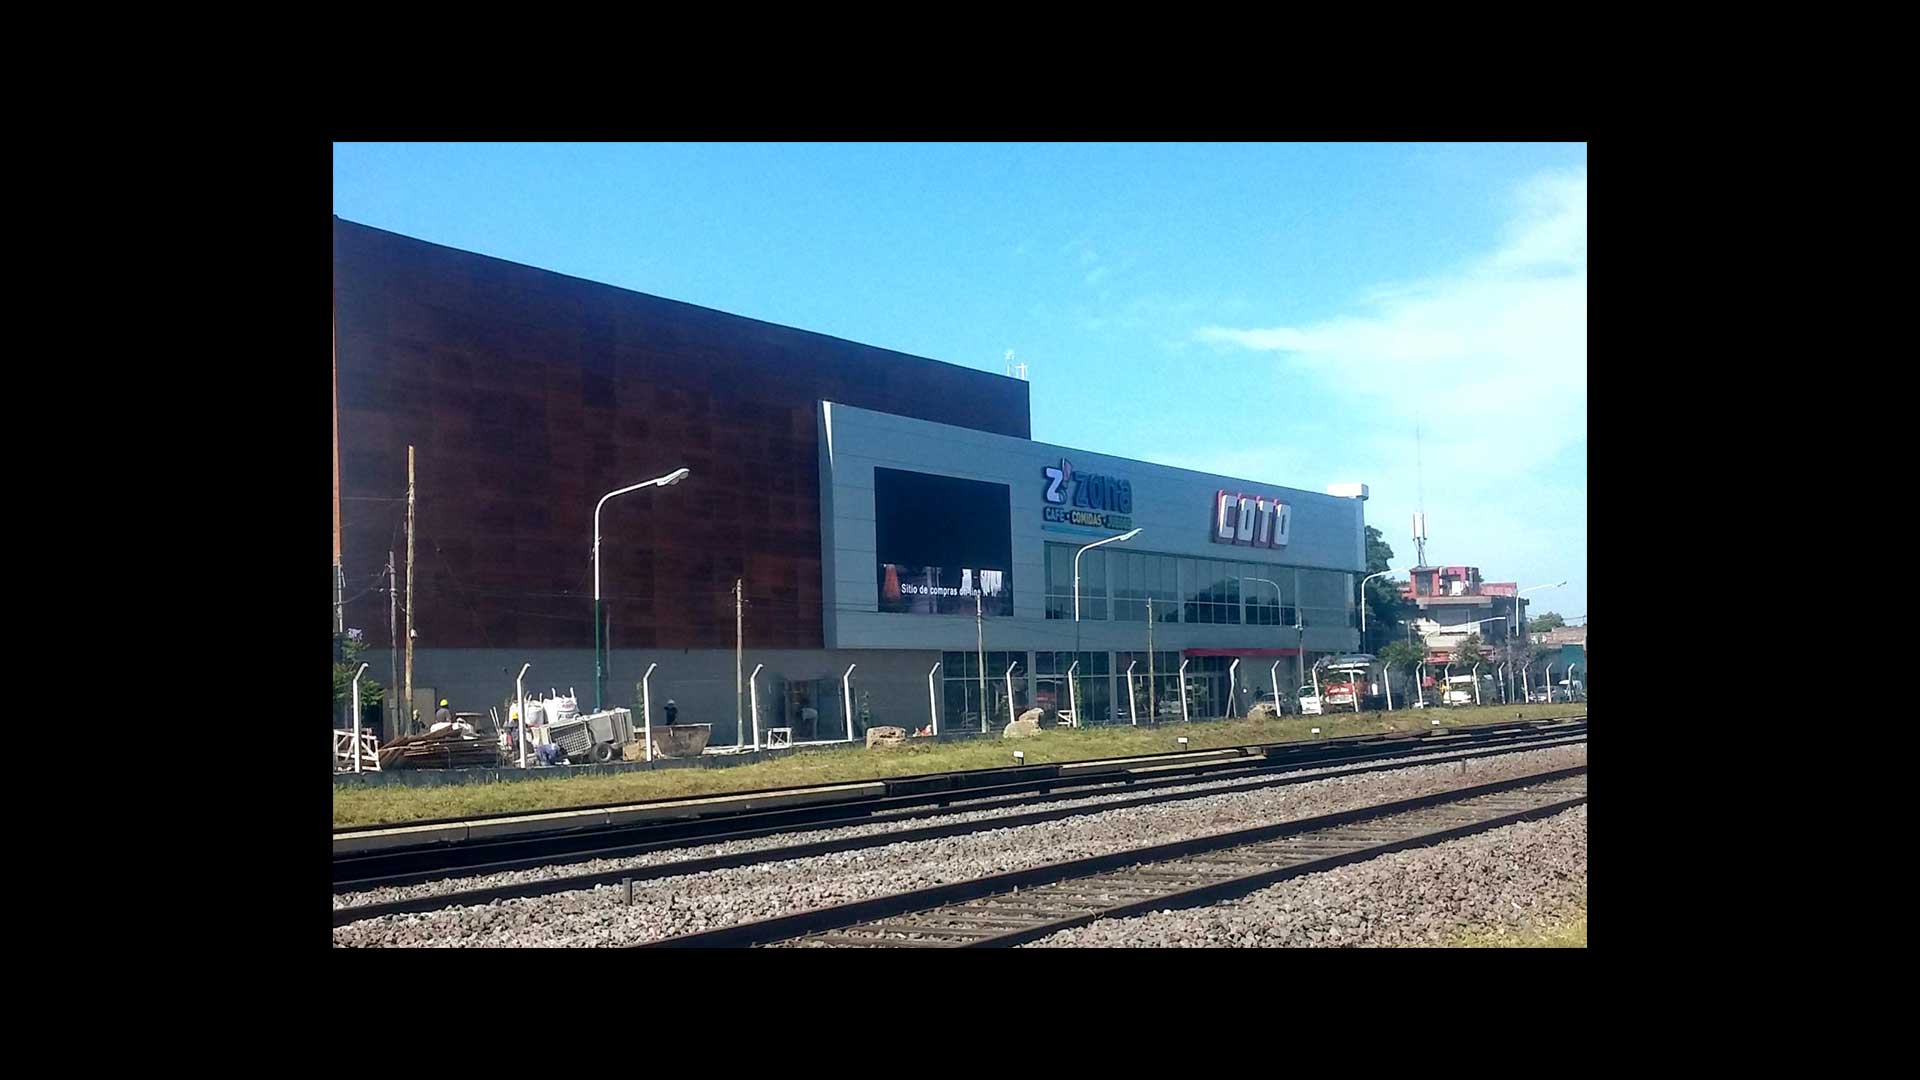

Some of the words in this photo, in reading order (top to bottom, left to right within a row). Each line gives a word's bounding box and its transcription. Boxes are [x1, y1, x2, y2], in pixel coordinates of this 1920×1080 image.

[1072, 471, 1133, 514] zona
[1070, 511, 1103, 527] COMIDAS
[1217, 491, 1291, 546] COTO
[901, 583, 918, 595] Sitio
[919, 585, 928, 595] de
[929, 587, 958, 598] compras
